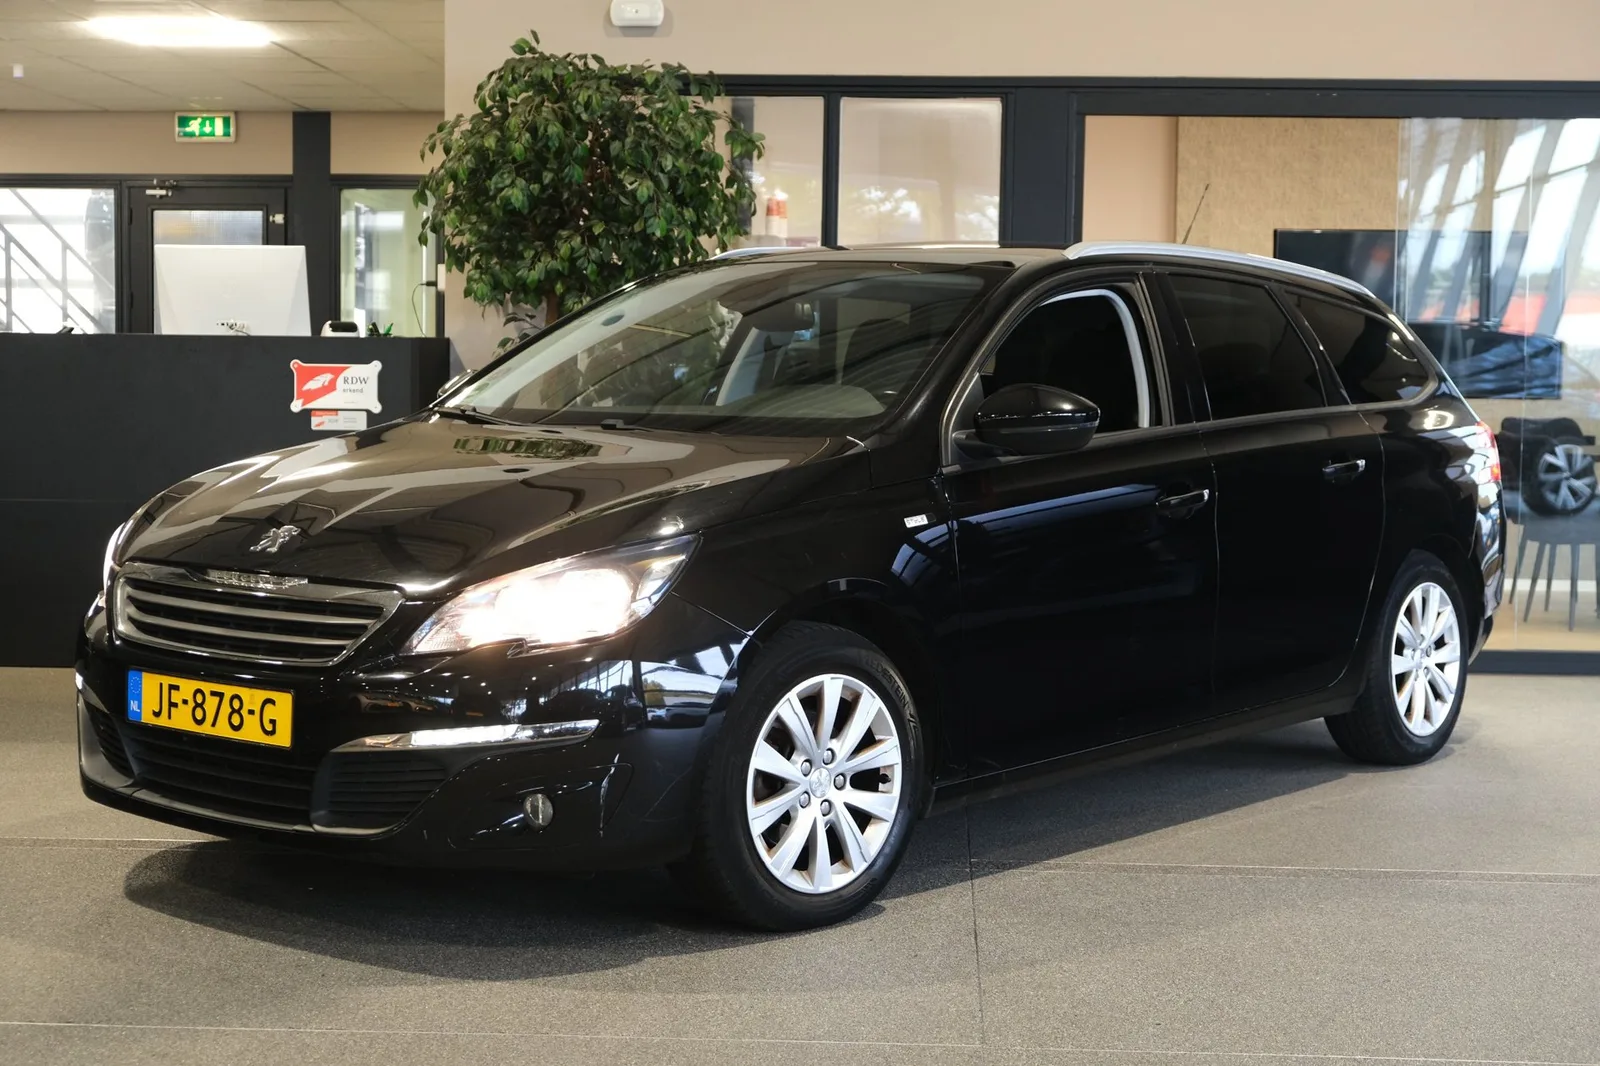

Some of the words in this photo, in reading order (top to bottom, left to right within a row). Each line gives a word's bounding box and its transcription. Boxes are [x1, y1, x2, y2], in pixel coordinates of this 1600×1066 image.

[343, 376, 369, 385] RDW
[130, 700, 140, 712] NL
[152, 682, 277, 737] JF-878-G
